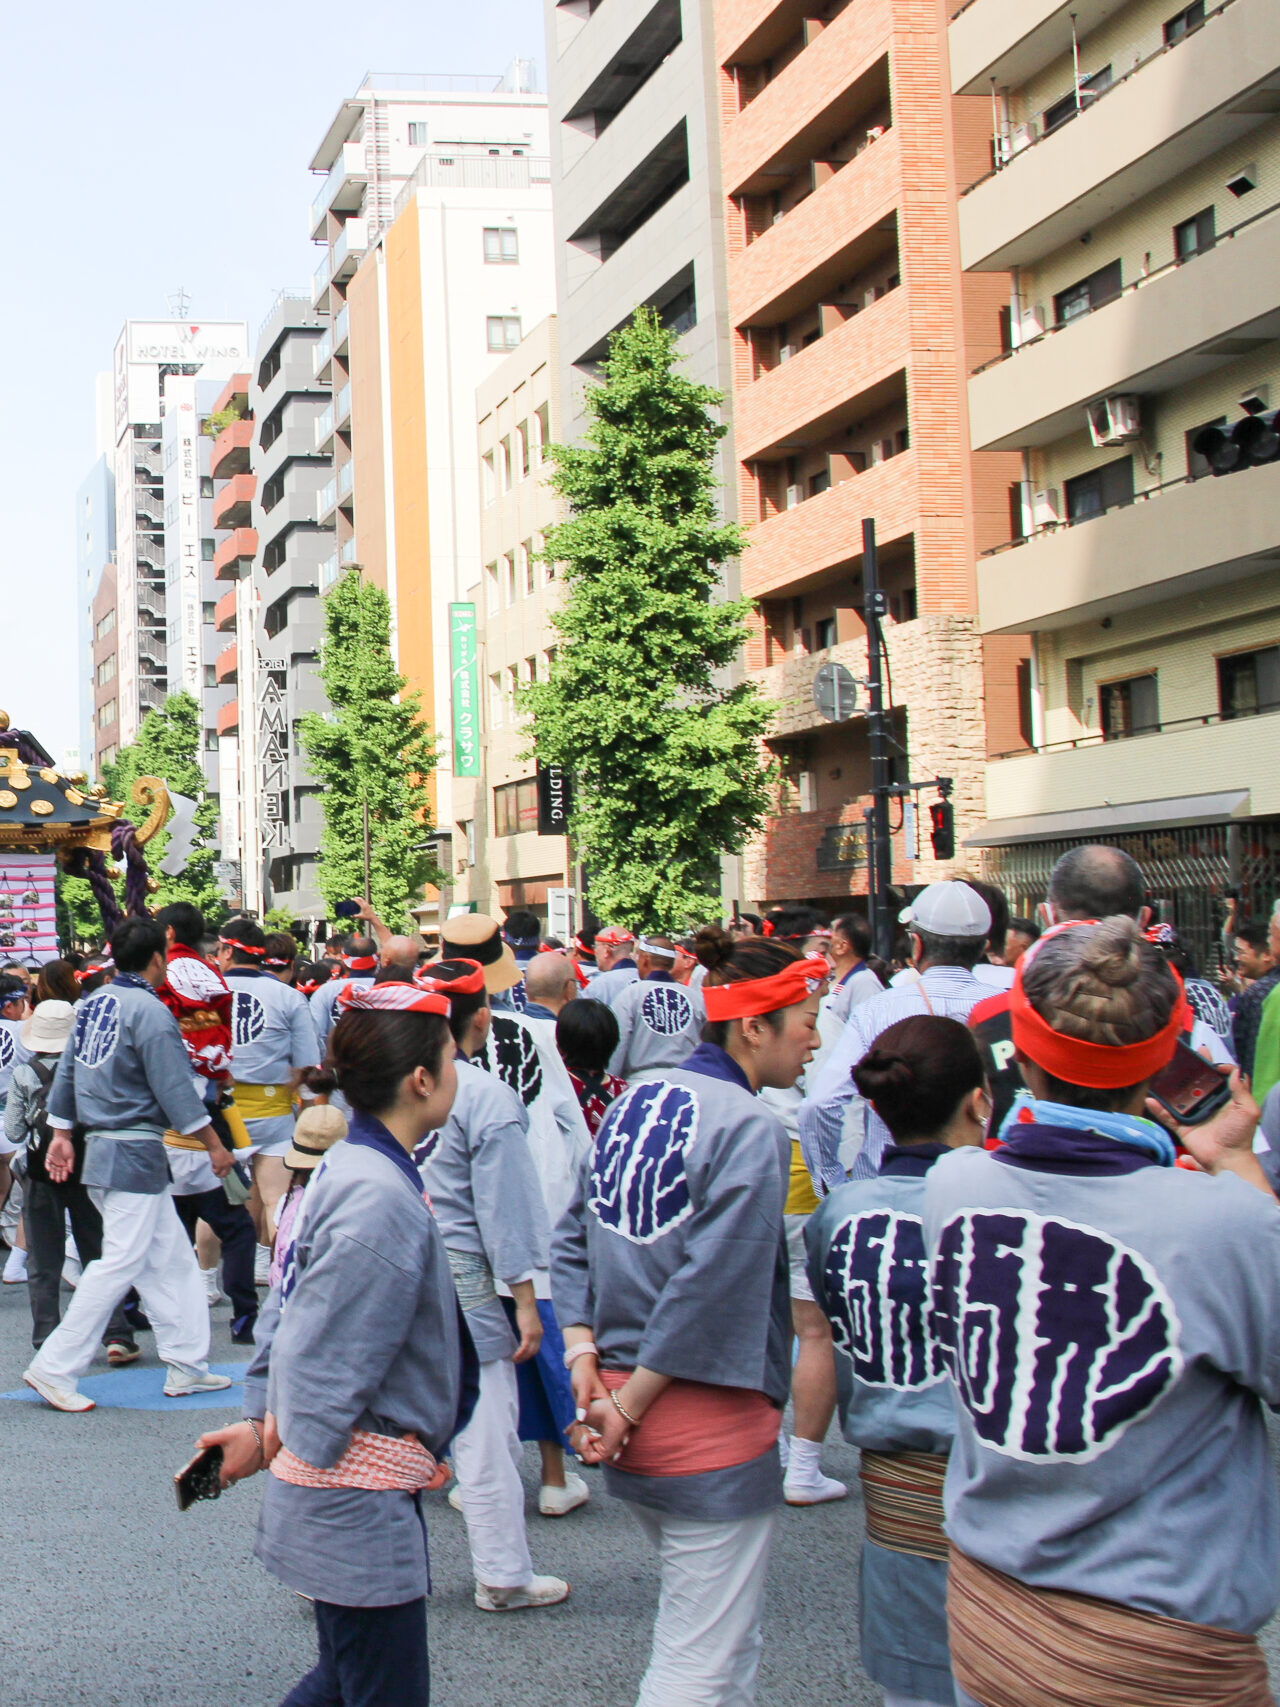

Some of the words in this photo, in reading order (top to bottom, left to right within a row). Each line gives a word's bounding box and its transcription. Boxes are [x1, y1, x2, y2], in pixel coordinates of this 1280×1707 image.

[137, 345, 187, 359] HOTEL
[192, 345, 240, 359] WING
[459, 711, 475, 768] クラサワ
